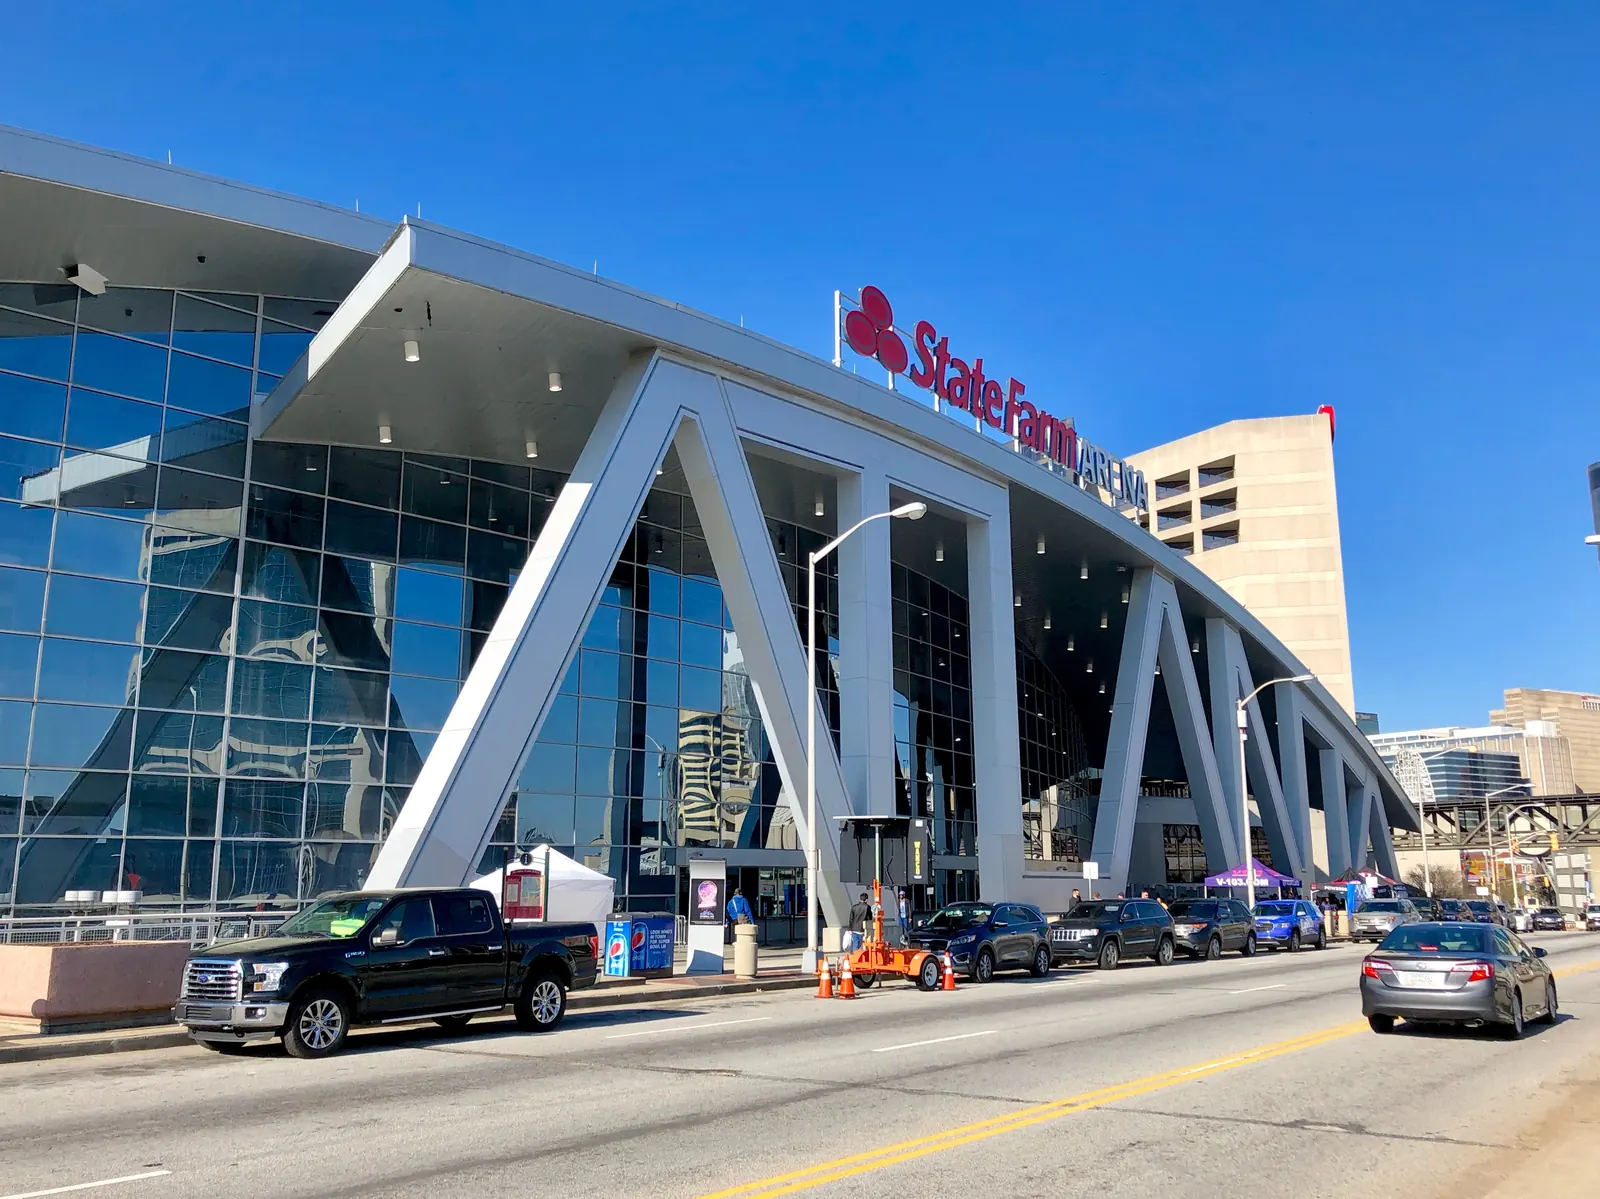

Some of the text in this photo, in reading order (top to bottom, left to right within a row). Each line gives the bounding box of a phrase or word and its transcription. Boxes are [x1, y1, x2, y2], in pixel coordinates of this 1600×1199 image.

[911, 320, 1149, 512] State Farm ARENA
